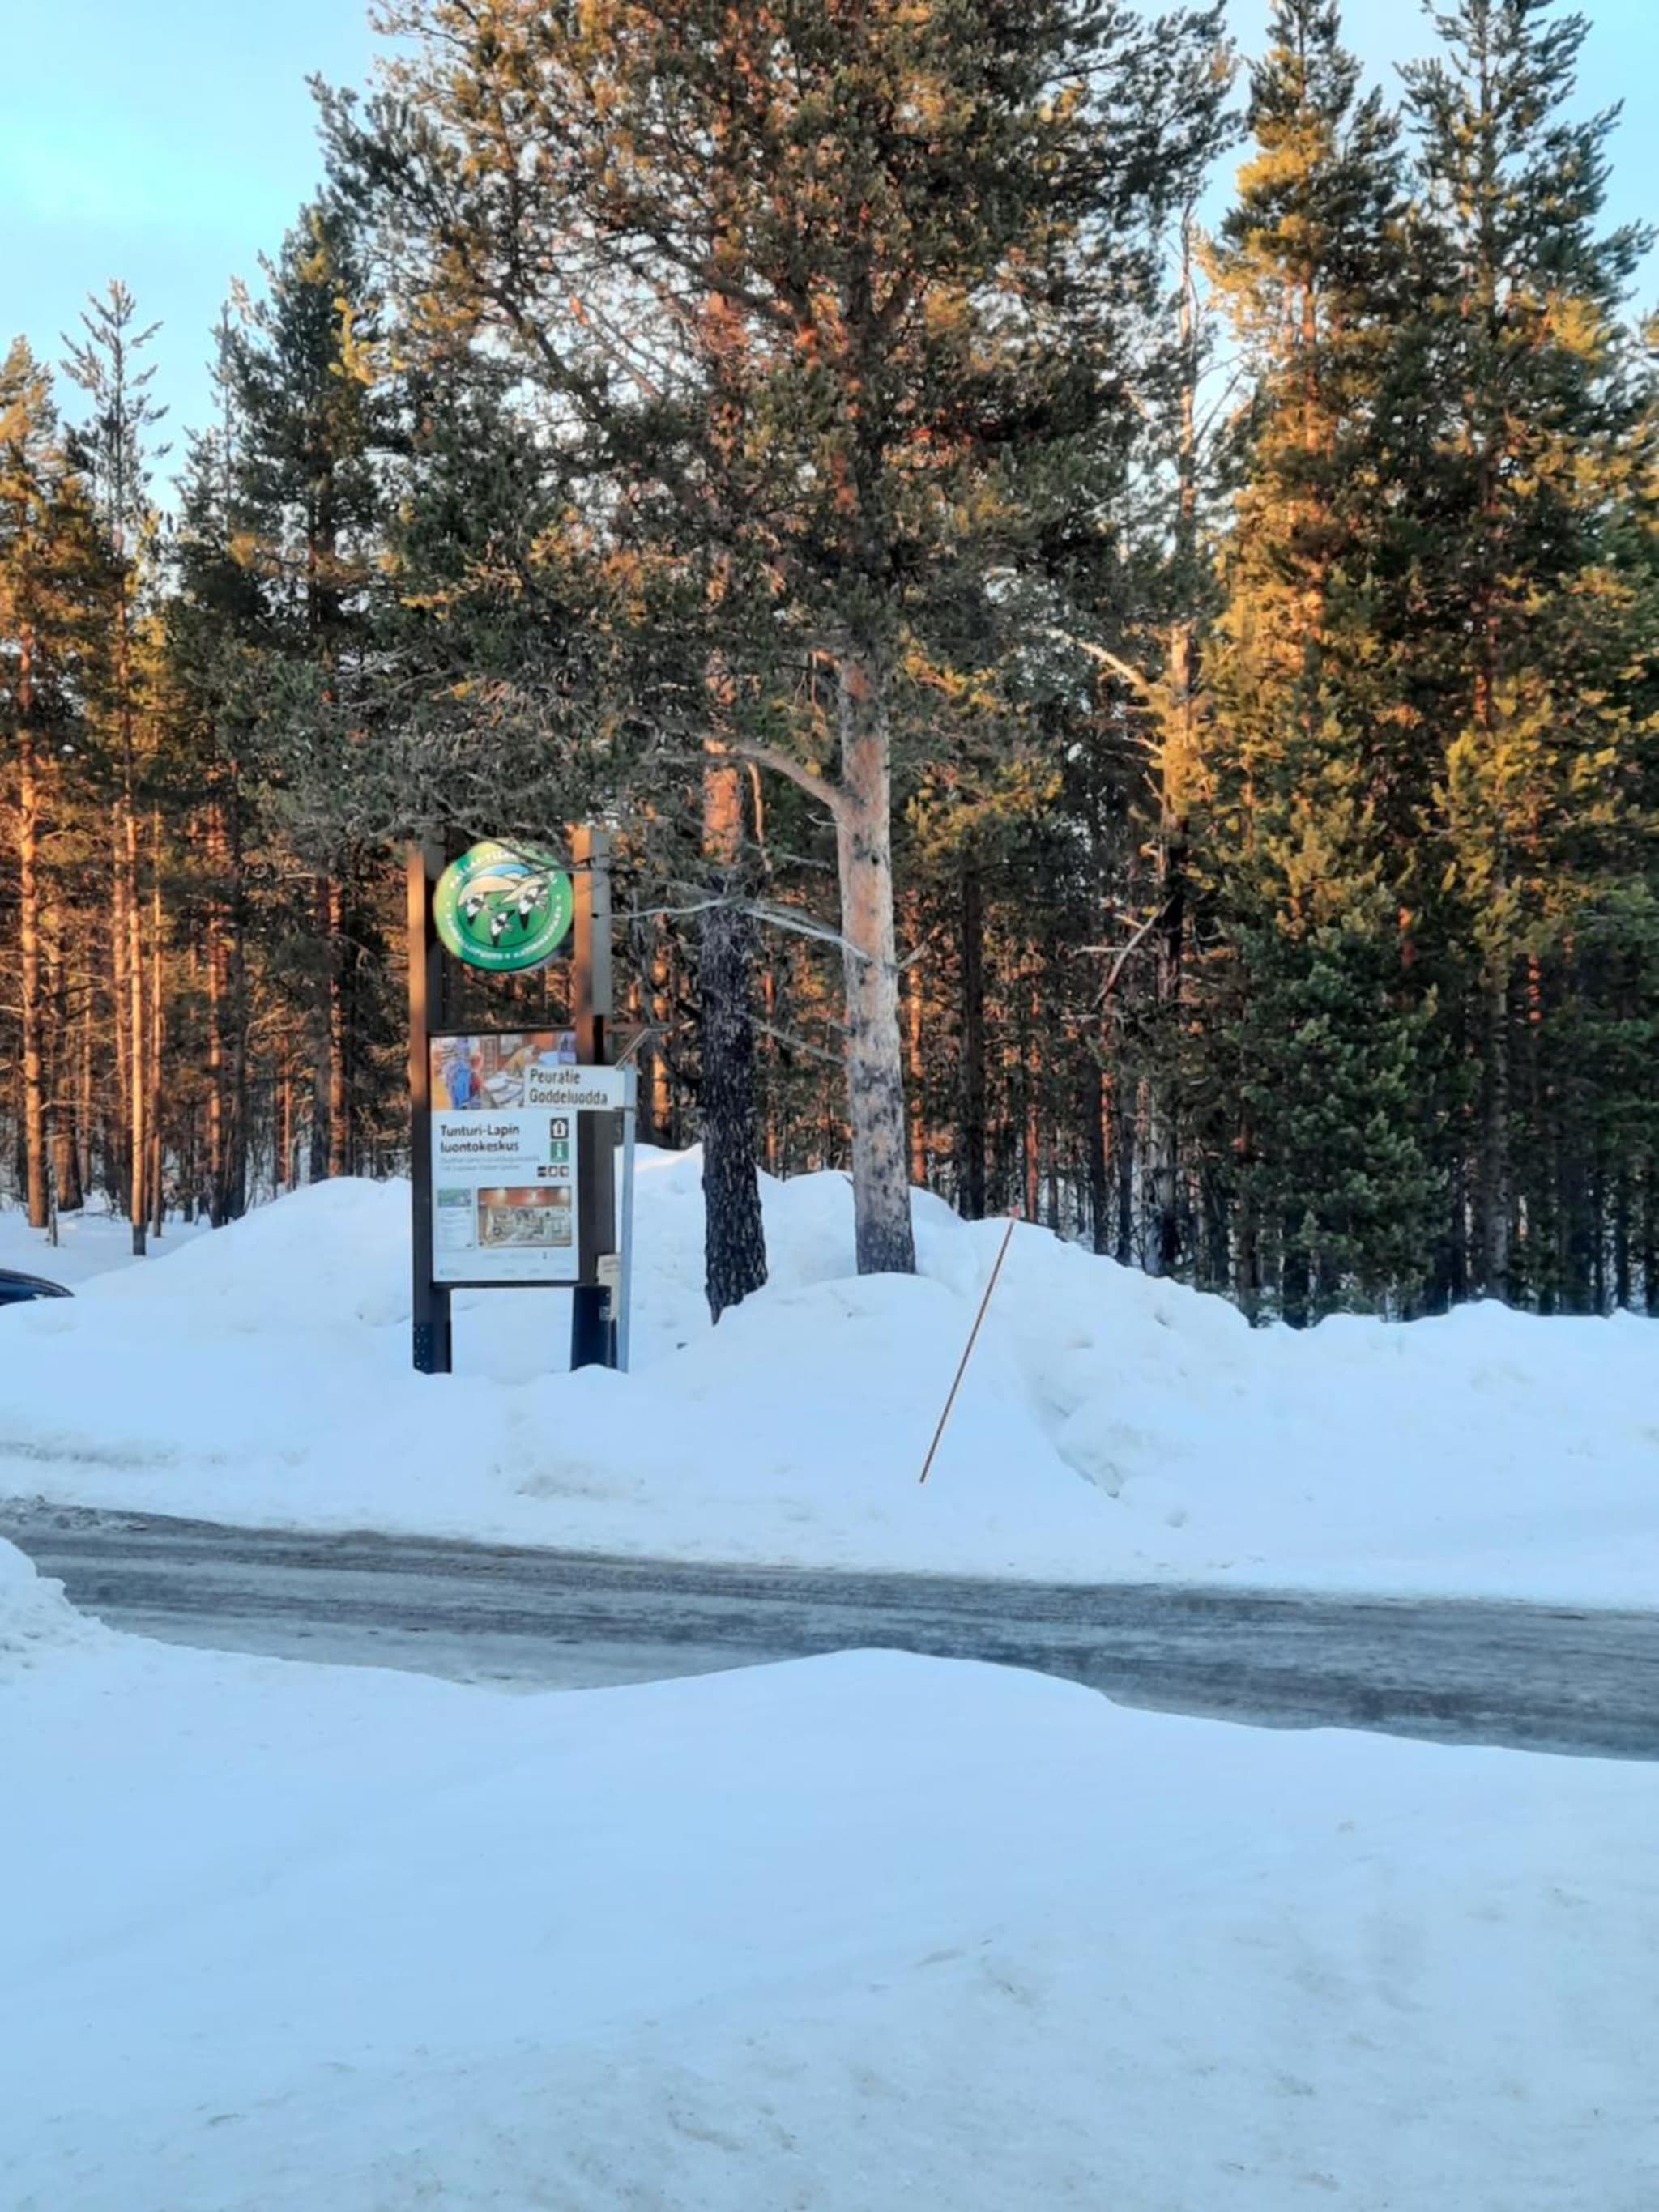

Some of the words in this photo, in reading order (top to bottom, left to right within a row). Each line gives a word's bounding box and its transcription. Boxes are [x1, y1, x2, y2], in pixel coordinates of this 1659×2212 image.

[530, 1068, 581, 1084] Peuratie
[529, 1087, 608, 1105] Goddeluodda
[440, 1123, 520, 1137] Tunturi-Lapin
[440, 1140, 520, 1153] luontokeskus
